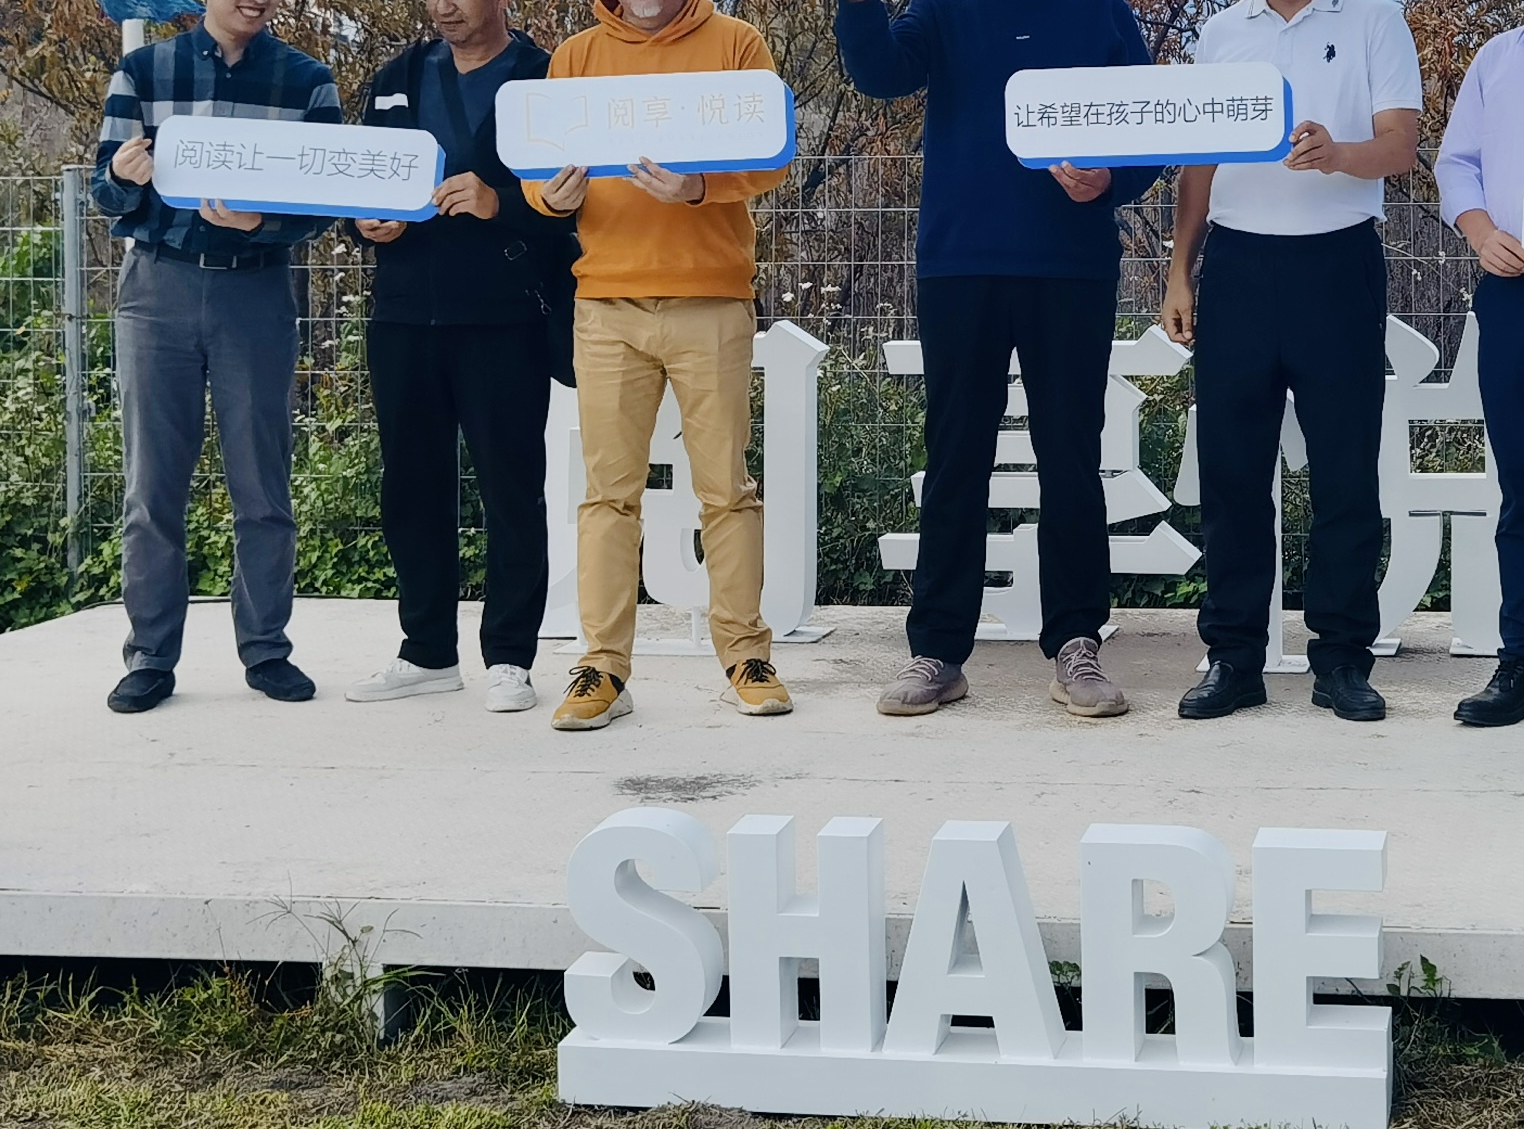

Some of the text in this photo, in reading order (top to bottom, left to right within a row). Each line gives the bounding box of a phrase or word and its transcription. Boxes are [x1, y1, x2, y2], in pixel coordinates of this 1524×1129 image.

[1013, 95, 1274, 128] 让希望在孩子的心中萌芽
[173, 138, 420, 181] 阅读让一切变美好
[563, 806, 1392, 1070] SHARE
